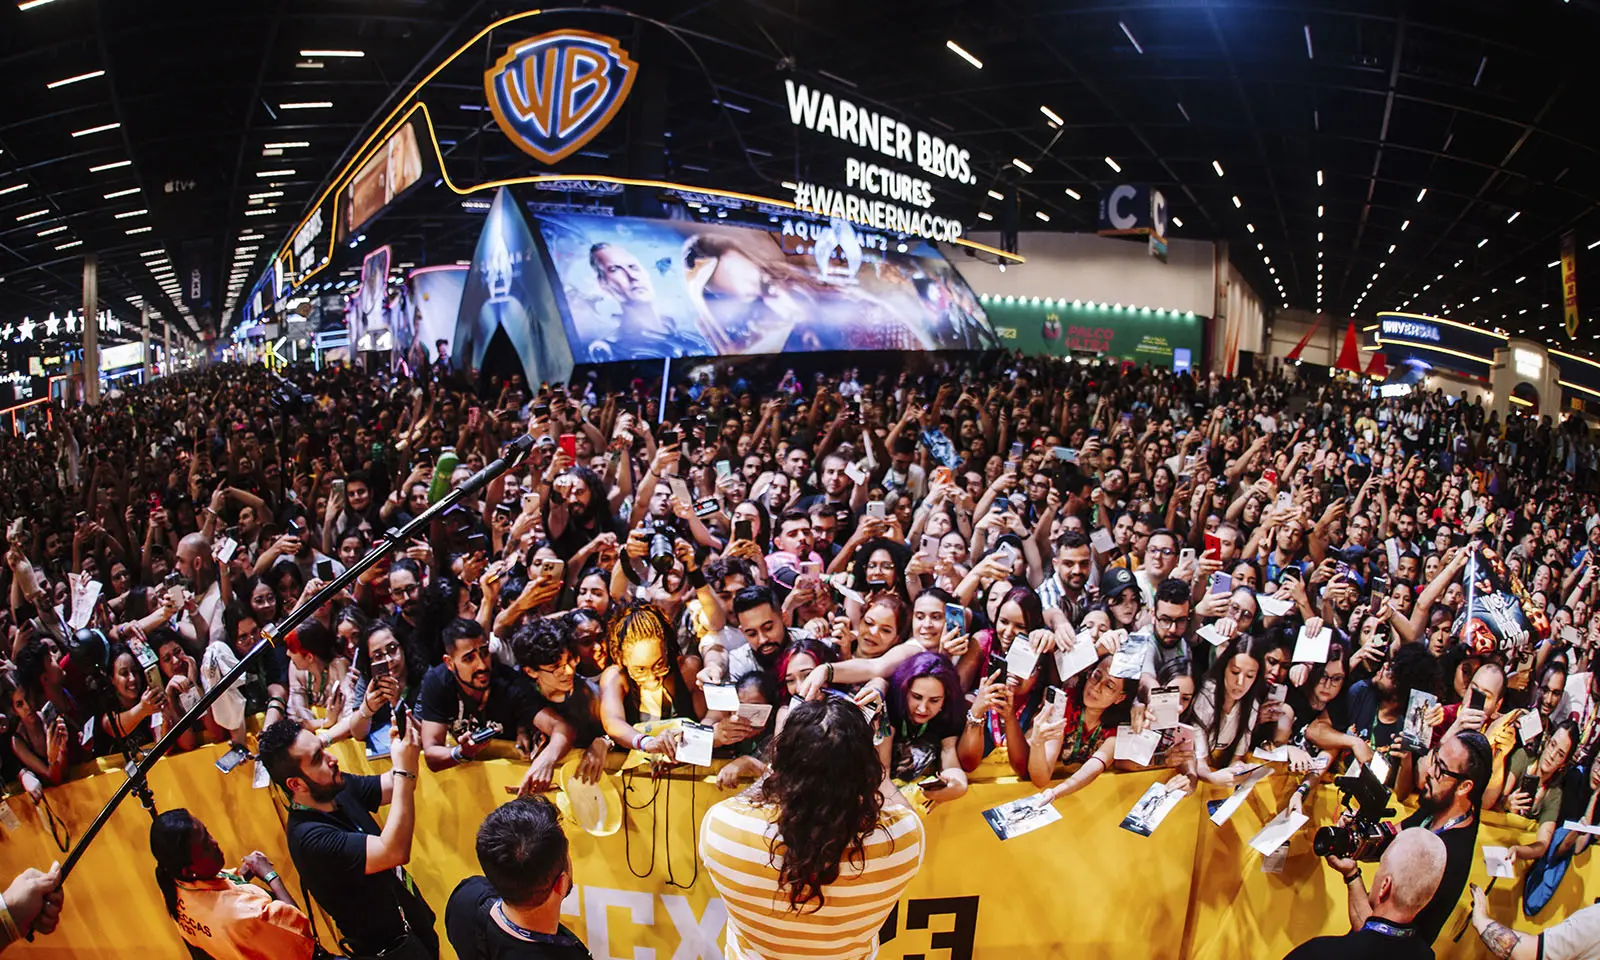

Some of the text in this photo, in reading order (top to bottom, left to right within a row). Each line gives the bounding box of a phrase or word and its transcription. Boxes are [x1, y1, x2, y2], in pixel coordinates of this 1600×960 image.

[503, 46, 611, 138] WB
[785, 79, 977, 185] WARNER BROS.
[846, 157, 933, 208] PICTURES
[794, 181, 962, 243] #WARNERNACCXP
[1108, 184, 1138, 230] C
[1153, 190, 1165, 238] C
[782, 219, 876, 248] AQUAN
[1064, 336, 1110, 352] ULTRA
[1067, 325, 1114, 341] PALCO
[1382, 320, 1441, 341] UNIVERSAL
